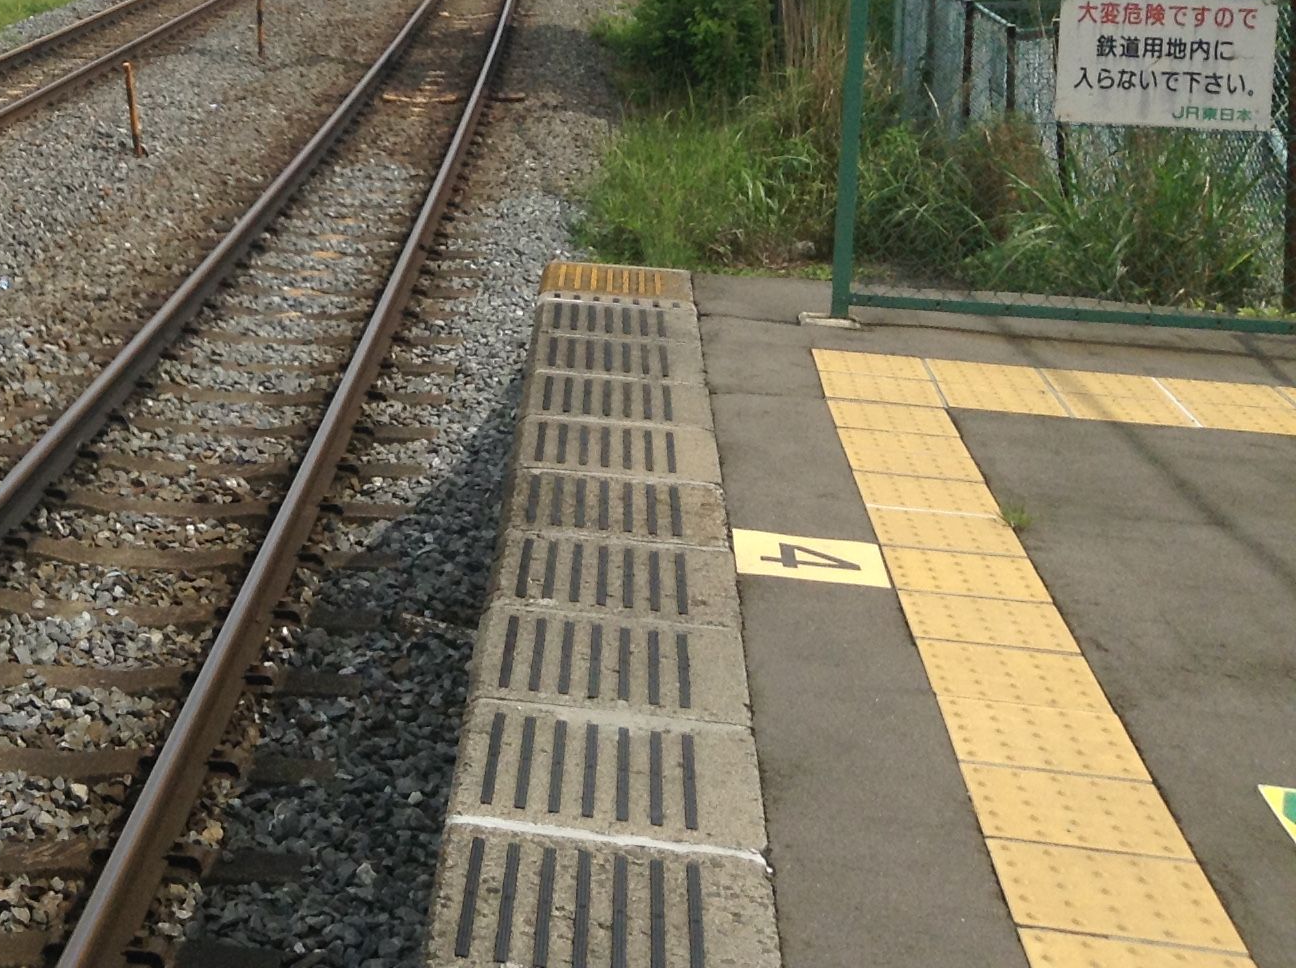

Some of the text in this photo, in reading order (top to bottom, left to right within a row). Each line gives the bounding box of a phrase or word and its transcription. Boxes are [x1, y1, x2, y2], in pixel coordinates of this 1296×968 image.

[1076, 0, 1259, 30] 大変危険ですので
[1095, 34, 1235, 61] 鉄道用地内に
[1073, 66, 1255, 97] 入らないで下さい。
[1171, 105, 1253, 121] JR東日本
[760, 542, 862, 571] 4
